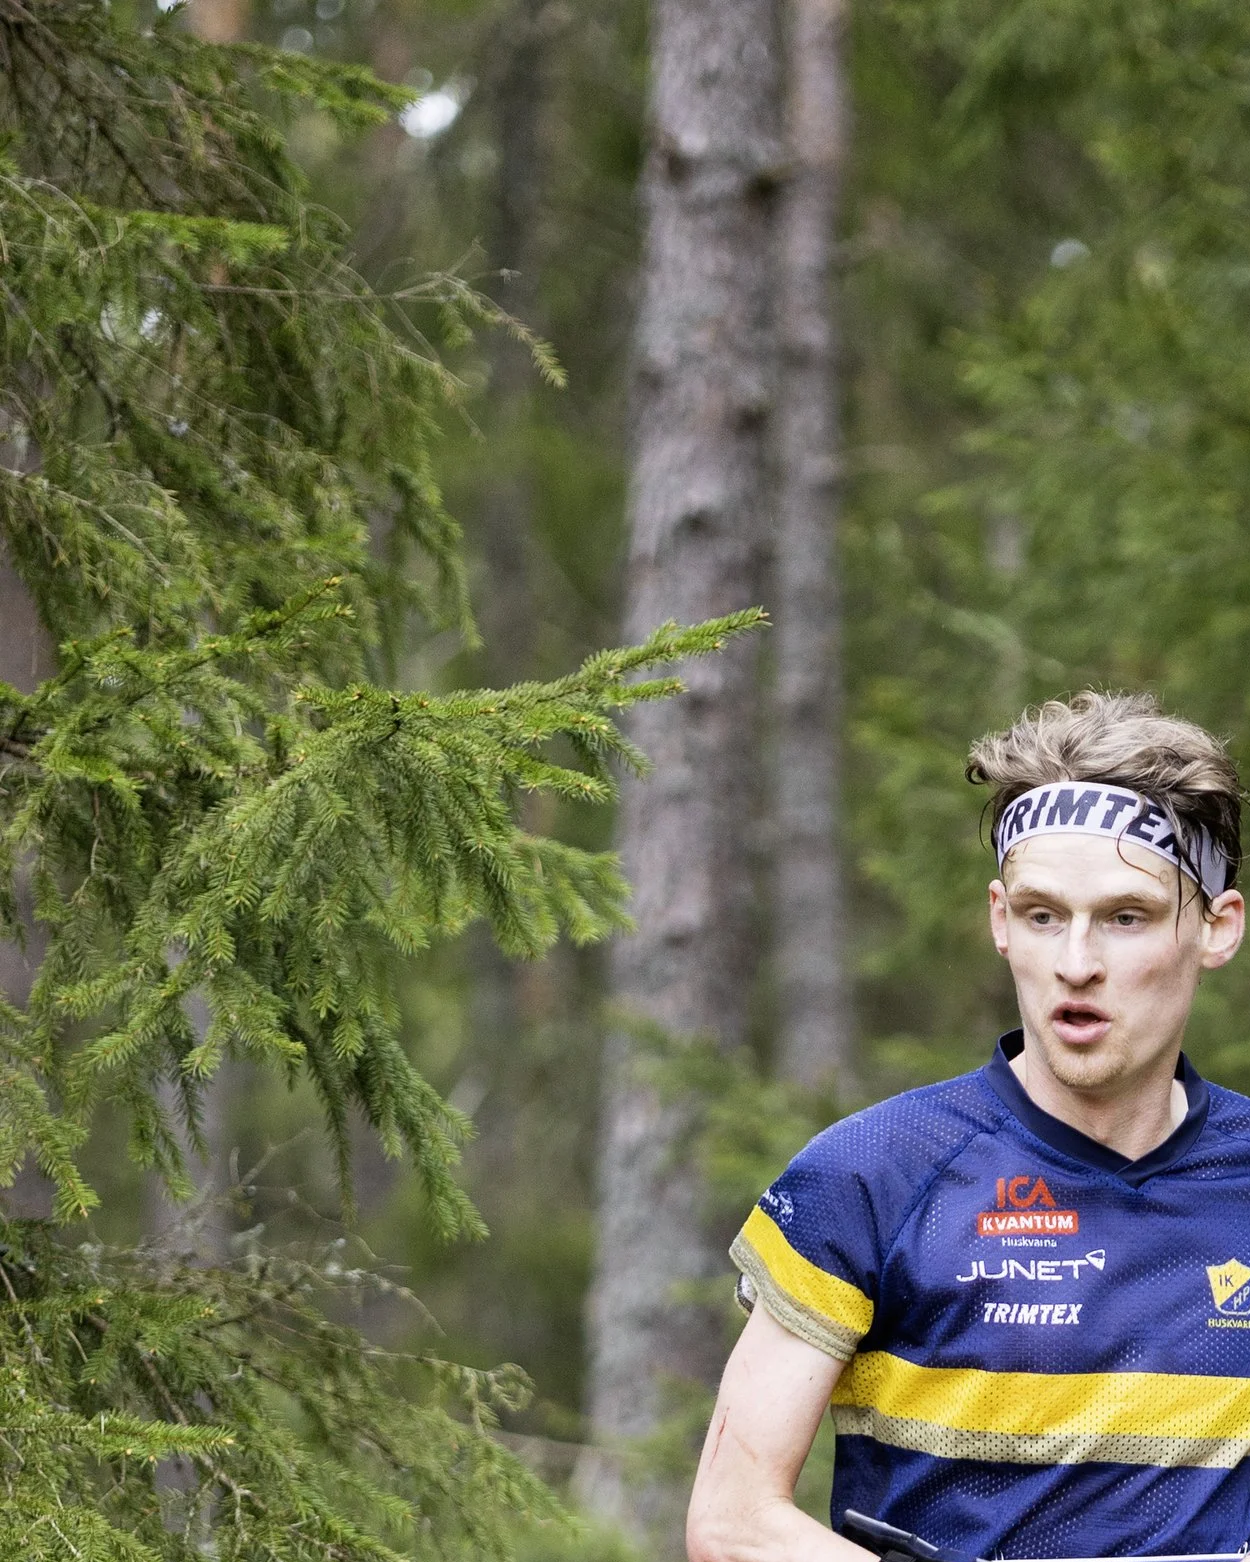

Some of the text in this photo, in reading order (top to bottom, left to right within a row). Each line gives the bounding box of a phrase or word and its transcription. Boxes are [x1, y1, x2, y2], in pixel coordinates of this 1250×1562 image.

[996, 1175, 1058, 1209] ICA
[982, 1214, 1075, 1232] KVANTUM
[1001, 1236, 1058, 1248] Huskvarna
[955, 1258, 1090, 1282] JUNET
[1218, 1273, 1234, 1288] IK
[1233, 1285, 1250, 1311] HP
[983, 1302, 1083, 1325] TRIMTEX
